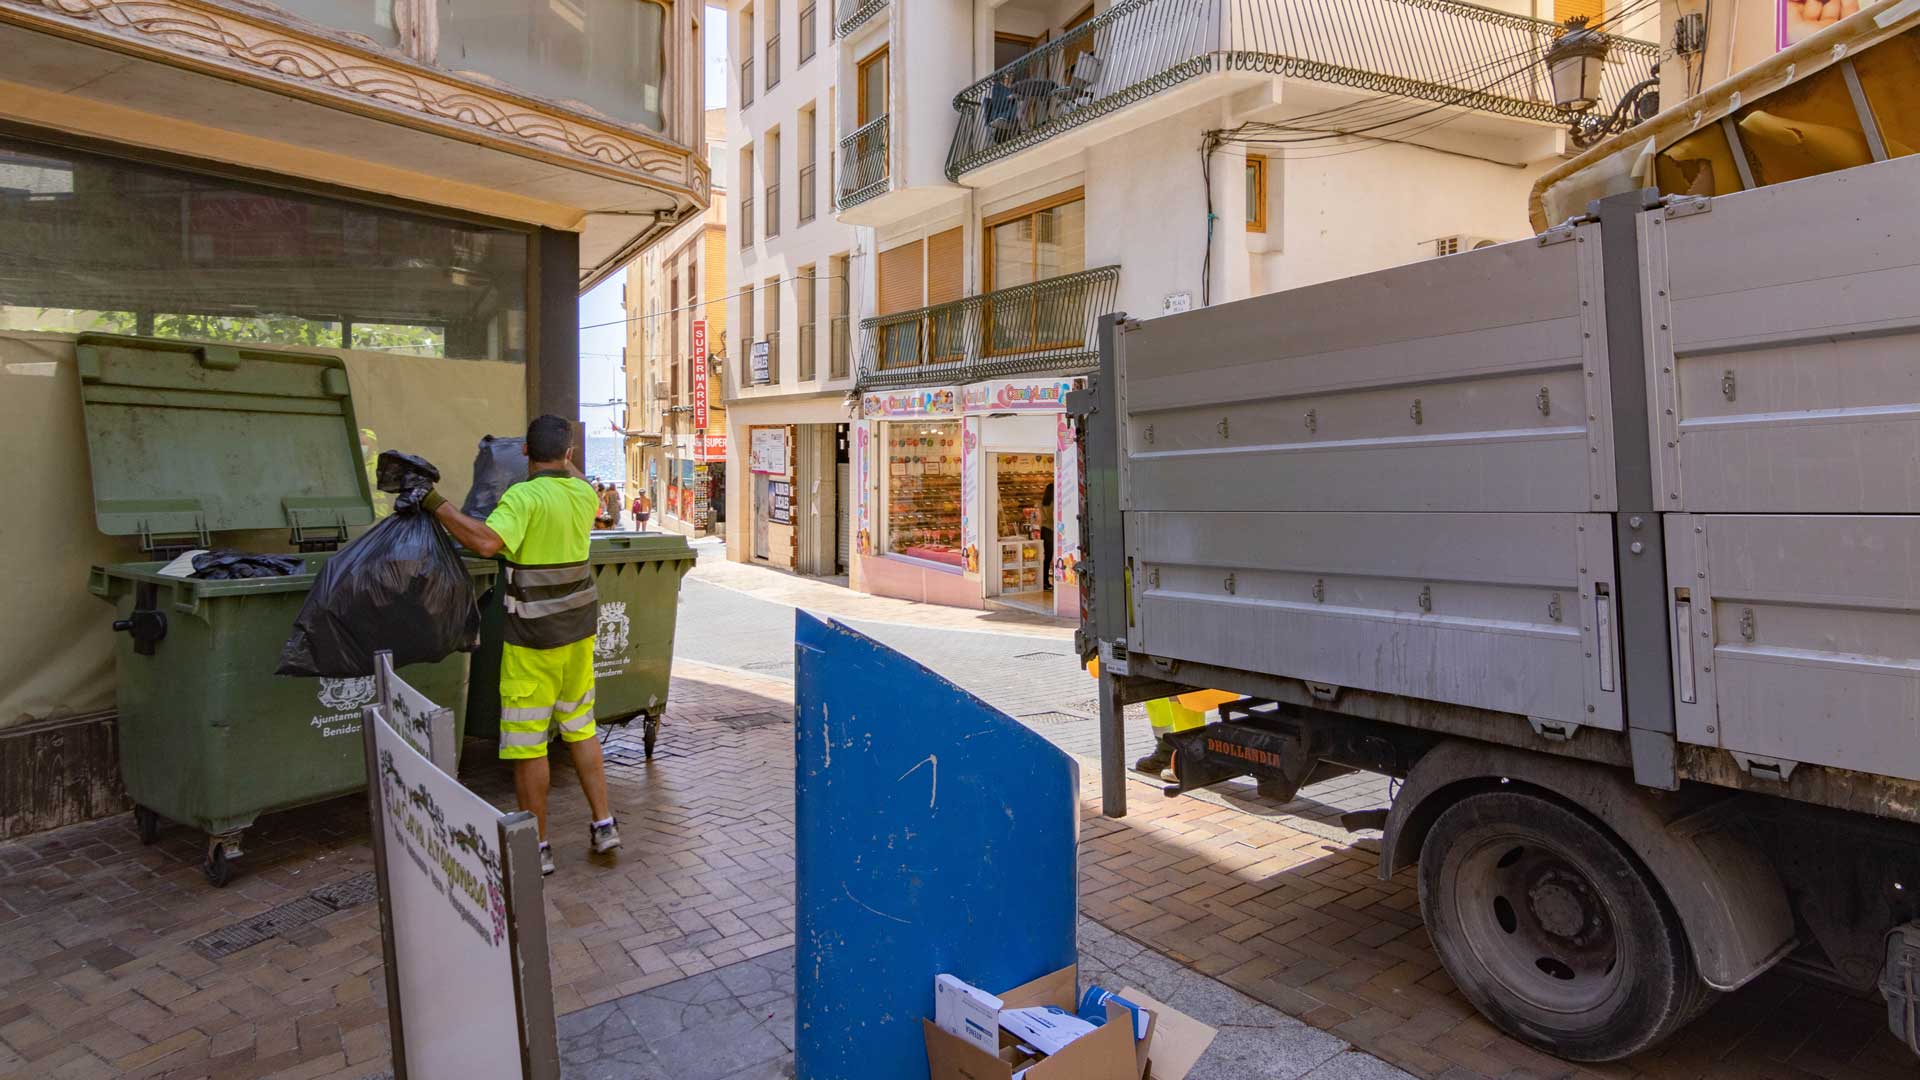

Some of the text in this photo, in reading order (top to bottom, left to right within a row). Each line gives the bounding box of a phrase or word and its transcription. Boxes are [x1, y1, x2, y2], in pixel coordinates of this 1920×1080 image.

[696, 330, 704, 425] SUPERMARKET
[310, 712, 362, 728] Ajuntame
[323, 723, 362, 737] Benidor
[1208, 738, 1280, 767] DHOLLANDIA
